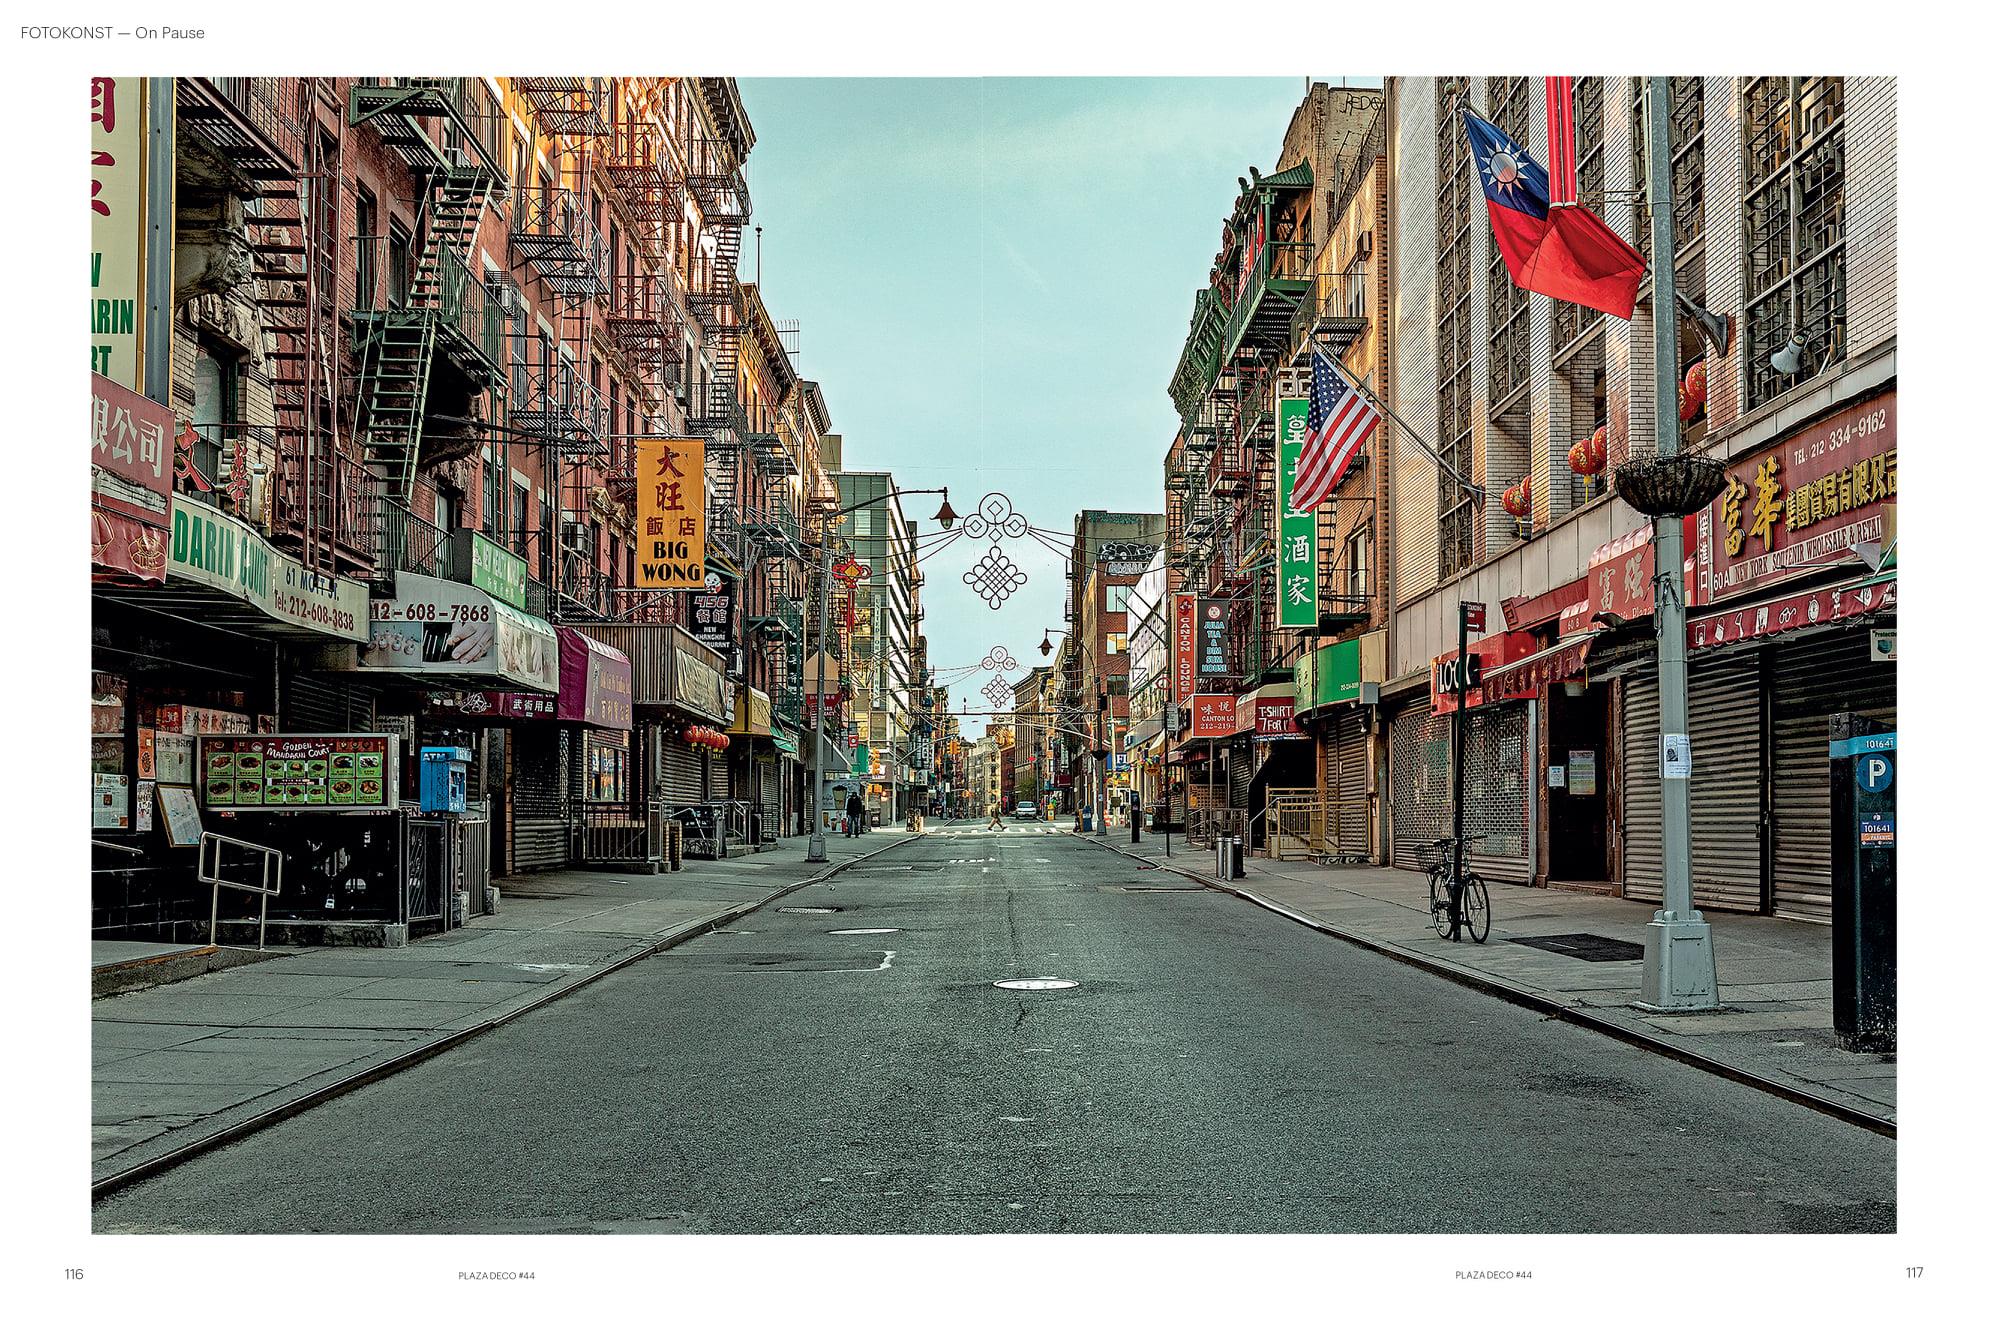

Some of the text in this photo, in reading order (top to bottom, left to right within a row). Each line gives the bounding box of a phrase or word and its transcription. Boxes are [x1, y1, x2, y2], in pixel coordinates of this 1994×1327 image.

[1829, 408, 1886, 451] 334-9162
[655, 445, 685, 512] 大旺
[646, 516, 696, 537] 飯店
[653, 541, 688, 560] BIG
[1735, 561, 1748, 583] NEW
[1750, 556, 1768, 579] YORK
[1806, 533, 1848, 564] WHOLESALE
[286, 566, 296, 587] 61
[642, 563, 701, 582] WONG
[694, 596, 729, 608] 456
[274, 589, 354, 632] Tel: 212-608-3838
[1203, 621, 1225, 629] JULIA
[1180, 617, 1190, 652] CANTON
[1207, 630, 1222, 638] TEA
[1206, 646, 1222, 655] DIM
[1205, 656, 1223, 664] SUM
[1180, 657, 1190, 692] LOUNGE
[1201, 664, 1227, 673] HOUSE
[513, 699, 554, 713] 武術用品
[1258, 705, 1293, 717] T-SHIRT
[1259, 717, 1267, 731] 7
[1267, 719, 1282, 731] FOR
[282, 741, 313, 751] GOLDEN
[1865, 736, 1894, 749] 101641
[423, 752, 446, 761] ATM
[1869, 759, 1886, 787] P
[1864, 824, 1890, 833] 101641
